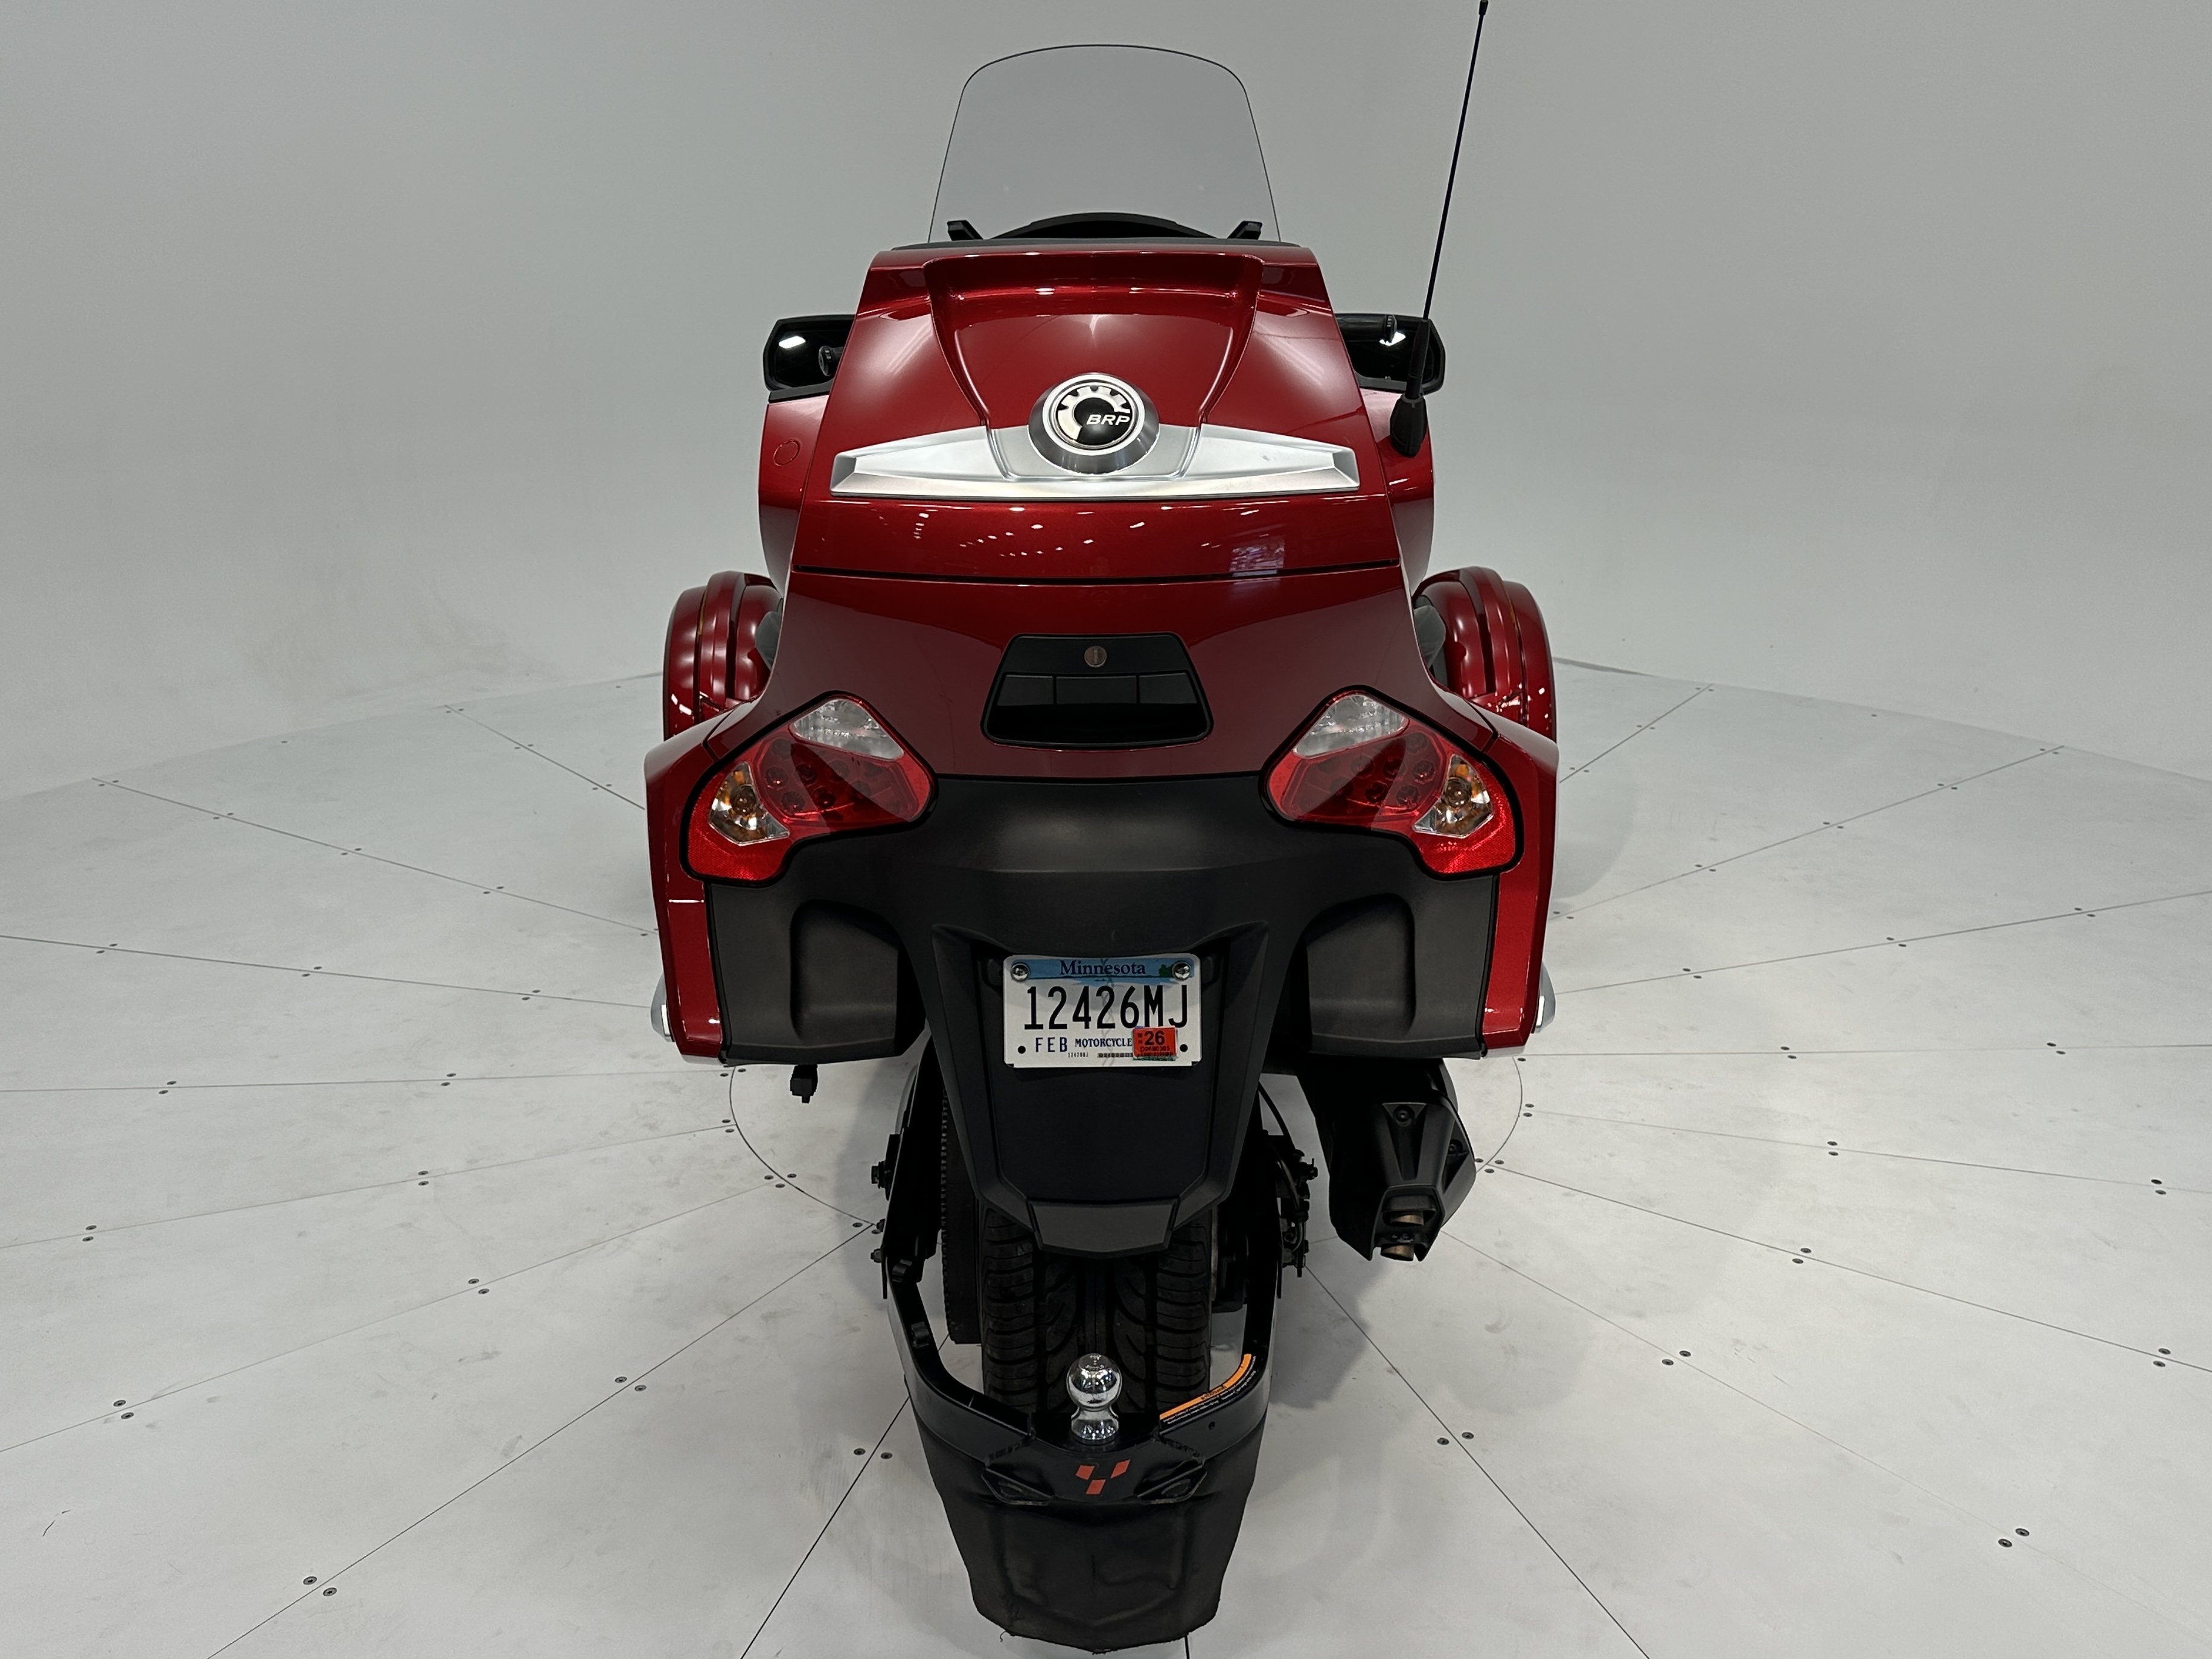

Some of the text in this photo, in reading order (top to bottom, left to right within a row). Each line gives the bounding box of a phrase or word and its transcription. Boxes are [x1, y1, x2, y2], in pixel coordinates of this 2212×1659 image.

[1086, 414, 1130, 426] BRP
[1060, 960, 1146, 976] Minnesota
[1024, 985, 1188, 1030] 12426MJ
[1035, 1037, 1133, 1053] FEB MOTORCYCLE
[1144, 1030, 1165, 1046] 26
